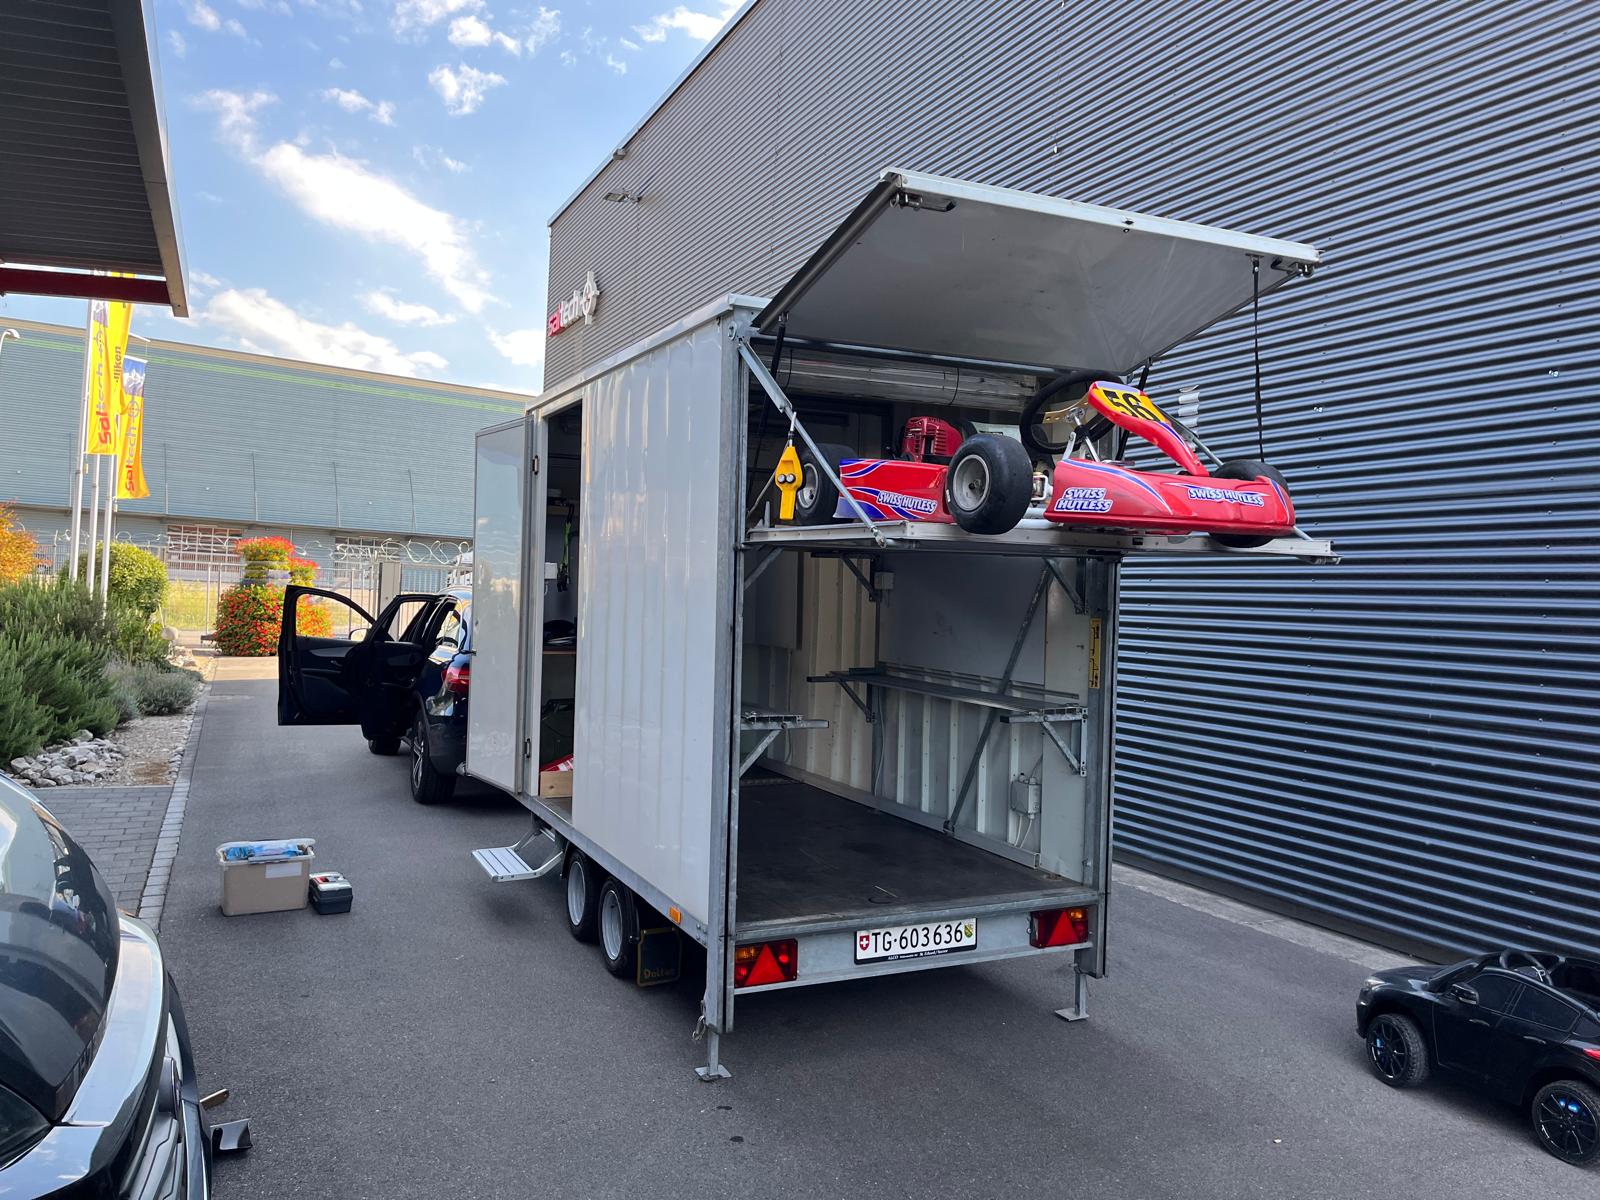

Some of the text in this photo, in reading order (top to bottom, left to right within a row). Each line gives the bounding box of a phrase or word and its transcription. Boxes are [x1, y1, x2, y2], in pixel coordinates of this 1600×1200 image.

[1103, 389, 1161, 421] 56
[125, 426, 137, 492] saltech
[878, 491, 937, 513] SWISS HUTLESS
[1064, 488, 1106, 500] SWISS
[1189, 487, 1264, 506] SWISS HUTLESS
[1056, 499, 1113, 511] HUTLESS
